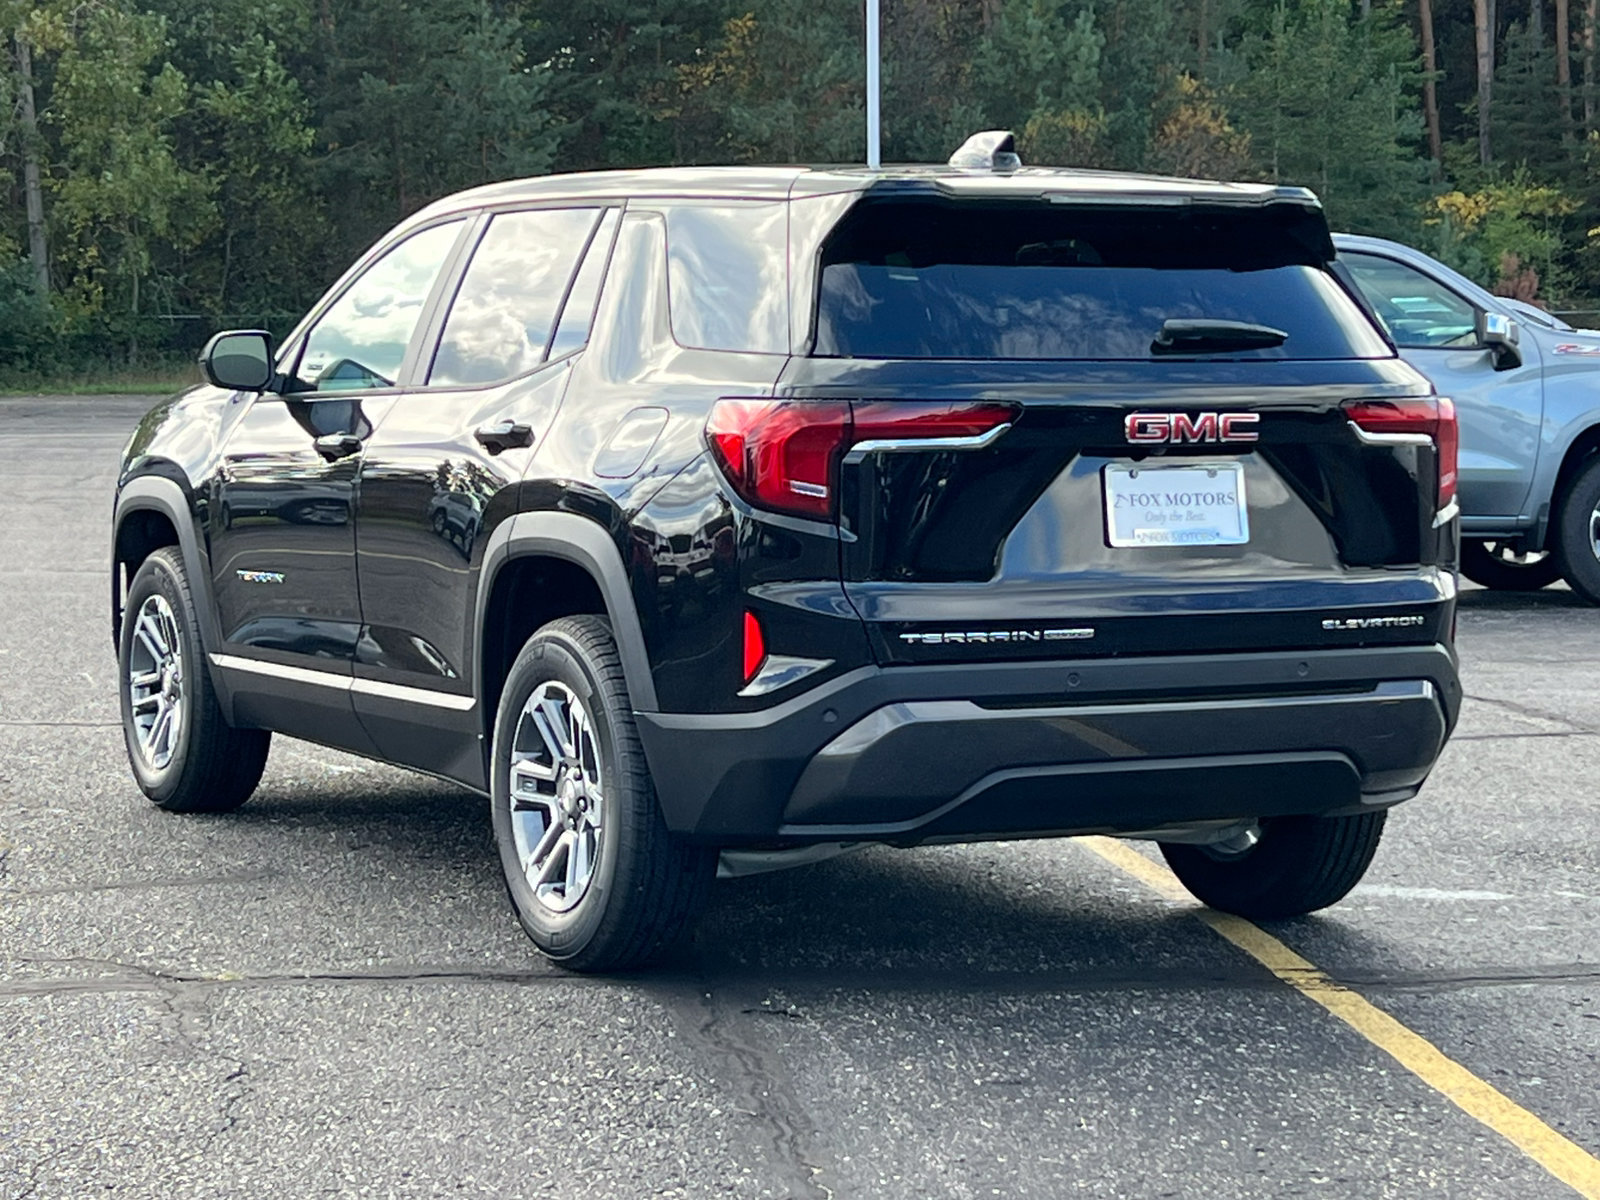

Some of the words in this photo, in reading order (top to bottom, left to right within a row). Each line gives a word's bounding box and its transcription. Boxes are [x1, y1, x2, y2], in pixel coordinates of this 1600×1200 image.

[1125, 412, 1260, 443] GMC
[1130, 493, 1161, 507] FOX
[1165, 492, 1235, 506] MOTORS
[1145, 510, 1167, 525] Only
[1169, 510, 1183, 522] the
[1322, 615, 1424, 629] ELEVATION
[900, 631, 1040, 643] TERRAIN
